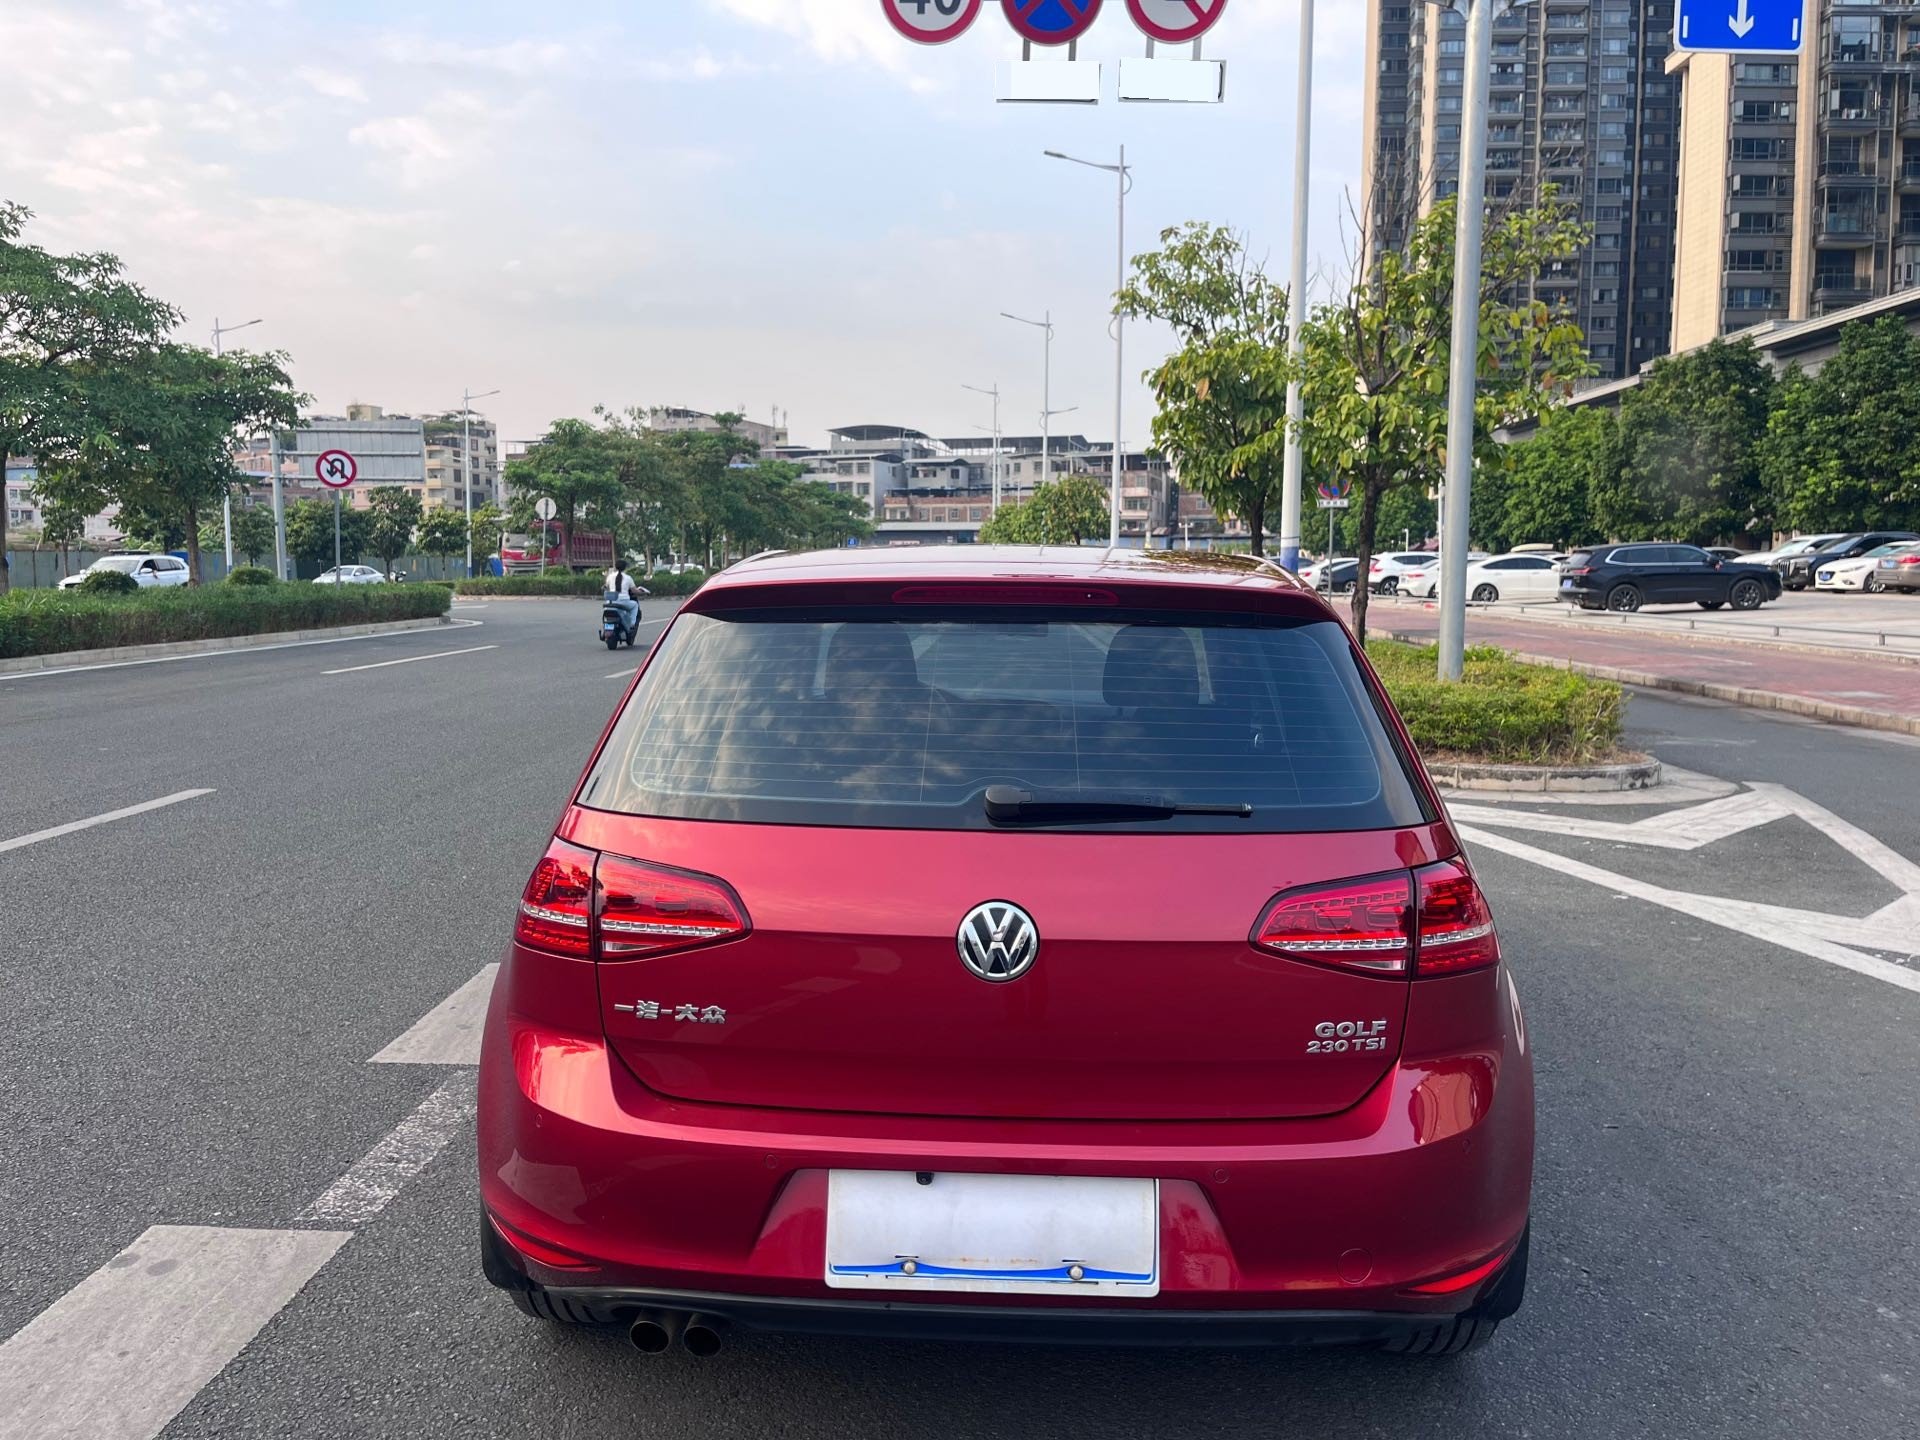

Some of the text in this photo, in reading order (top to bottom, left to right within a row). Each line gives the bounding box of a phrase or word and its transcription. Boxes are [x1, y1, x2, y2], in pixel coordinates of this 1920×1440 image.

[1315, 1020, 1387, 1038] GOLF
[1305, 1037, 1386, 1053] 230 TSI
